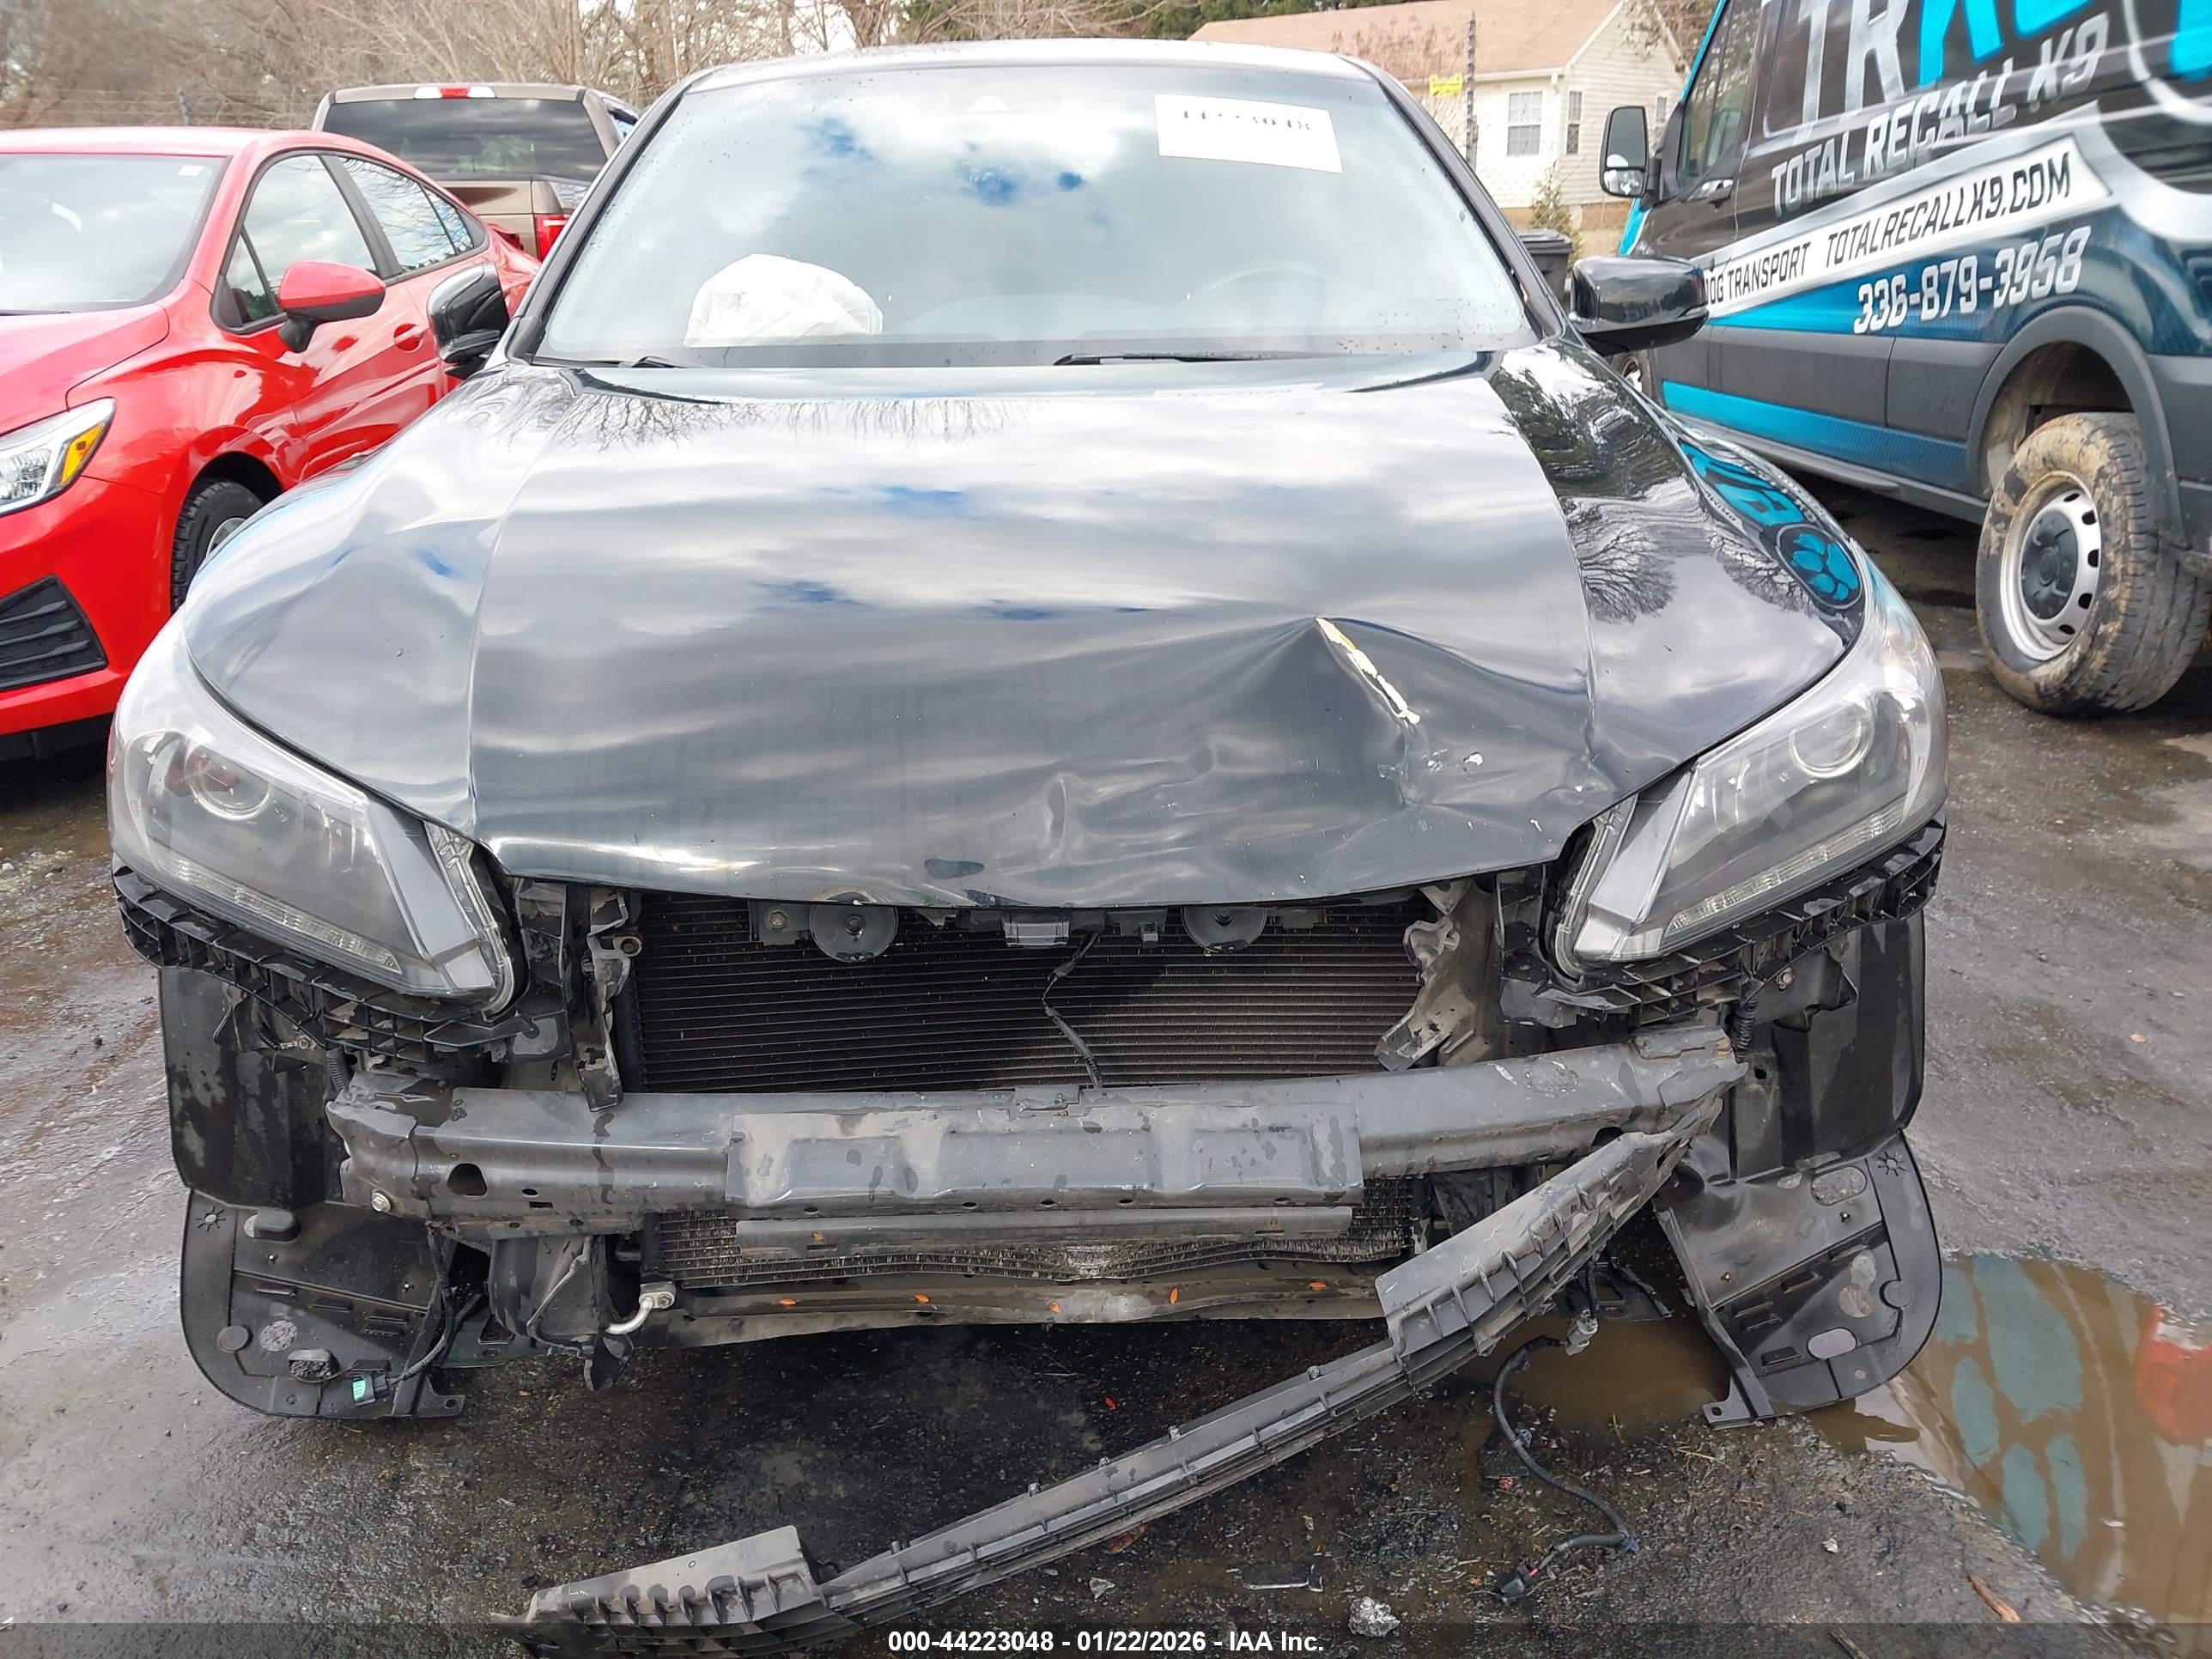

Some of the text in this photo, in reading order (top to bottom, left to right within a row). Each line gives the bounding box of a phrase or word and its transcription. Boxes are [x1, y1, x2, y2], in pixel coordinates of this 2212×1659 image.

[1771, 11, 2109, 217] TOTAL RECALL K9
[1728, 241, 1811, 300] TRANSPORT
[1826, 151, 2070, 269] TOTALRECALLK9.COM
[1854, 226, 2092, 334] 336-879-3958
